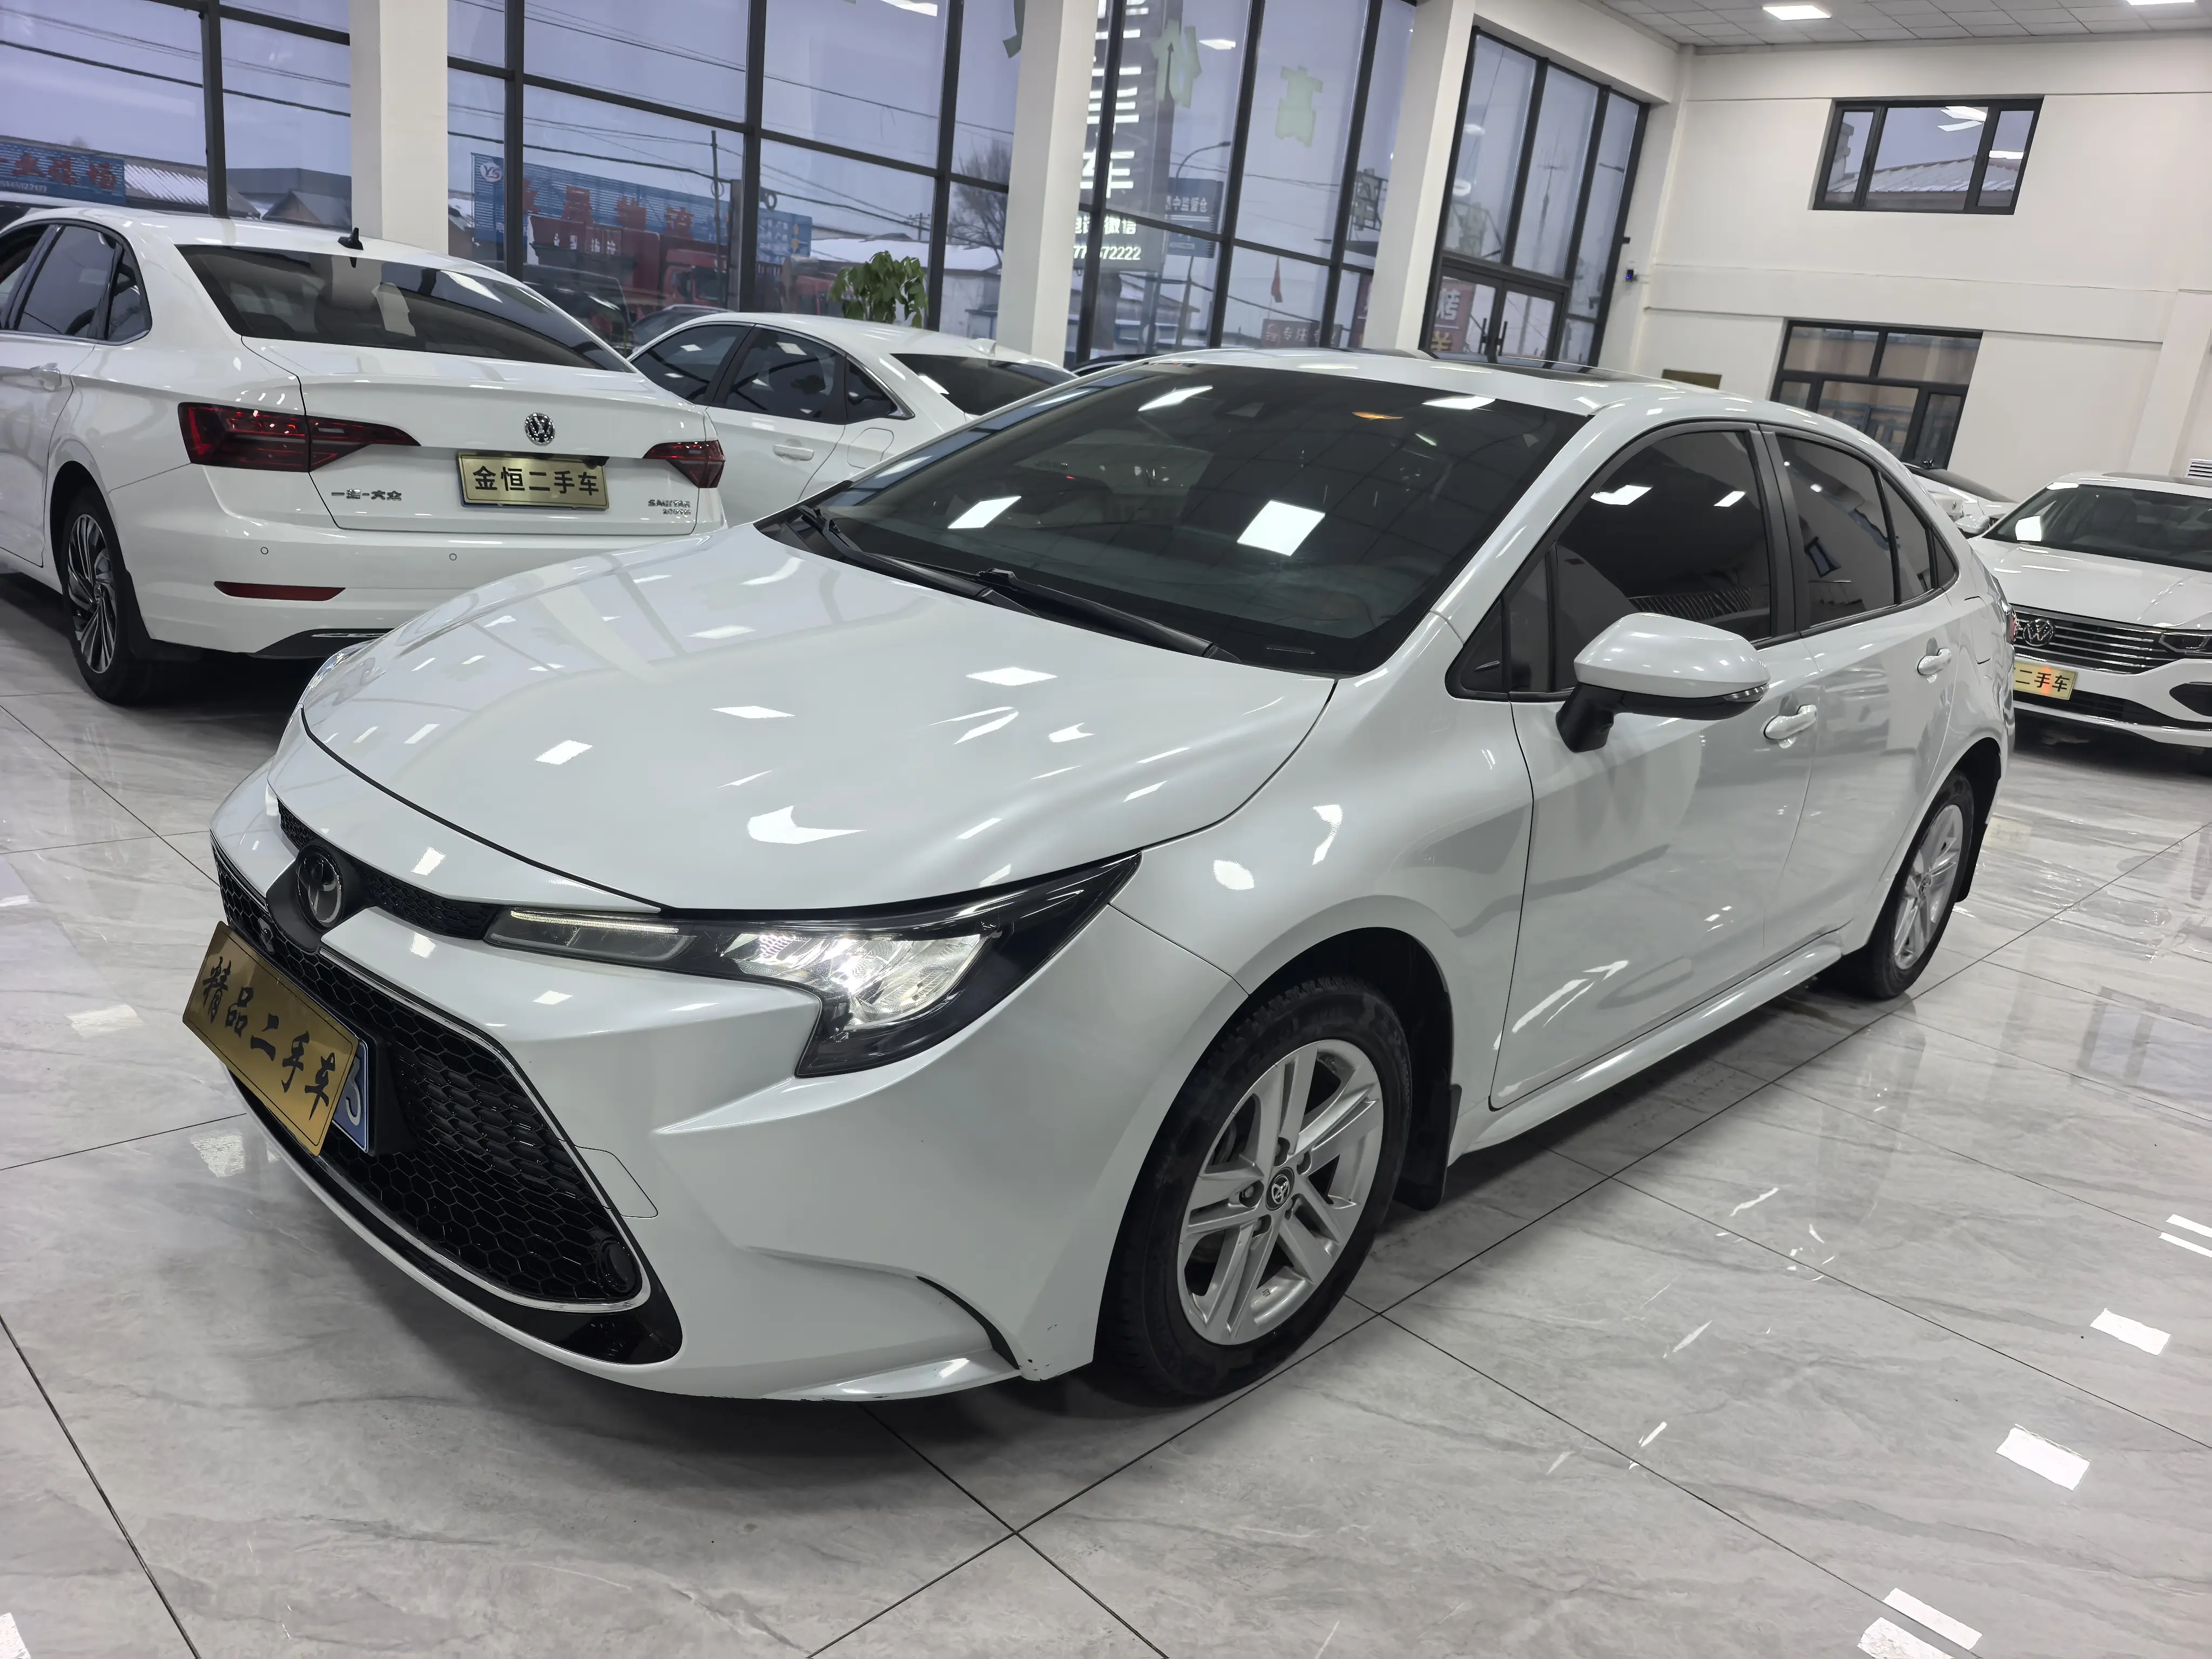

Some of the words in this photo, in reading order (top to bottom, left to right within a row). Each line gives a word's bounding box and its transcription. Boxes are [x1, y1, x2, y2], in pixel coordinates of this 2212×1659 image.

[473, 466, 599, 496] 金恒二手车
[2014, 667, 2070, 692] 二手车
[203, 956, 336, 1121] 精品二手车
